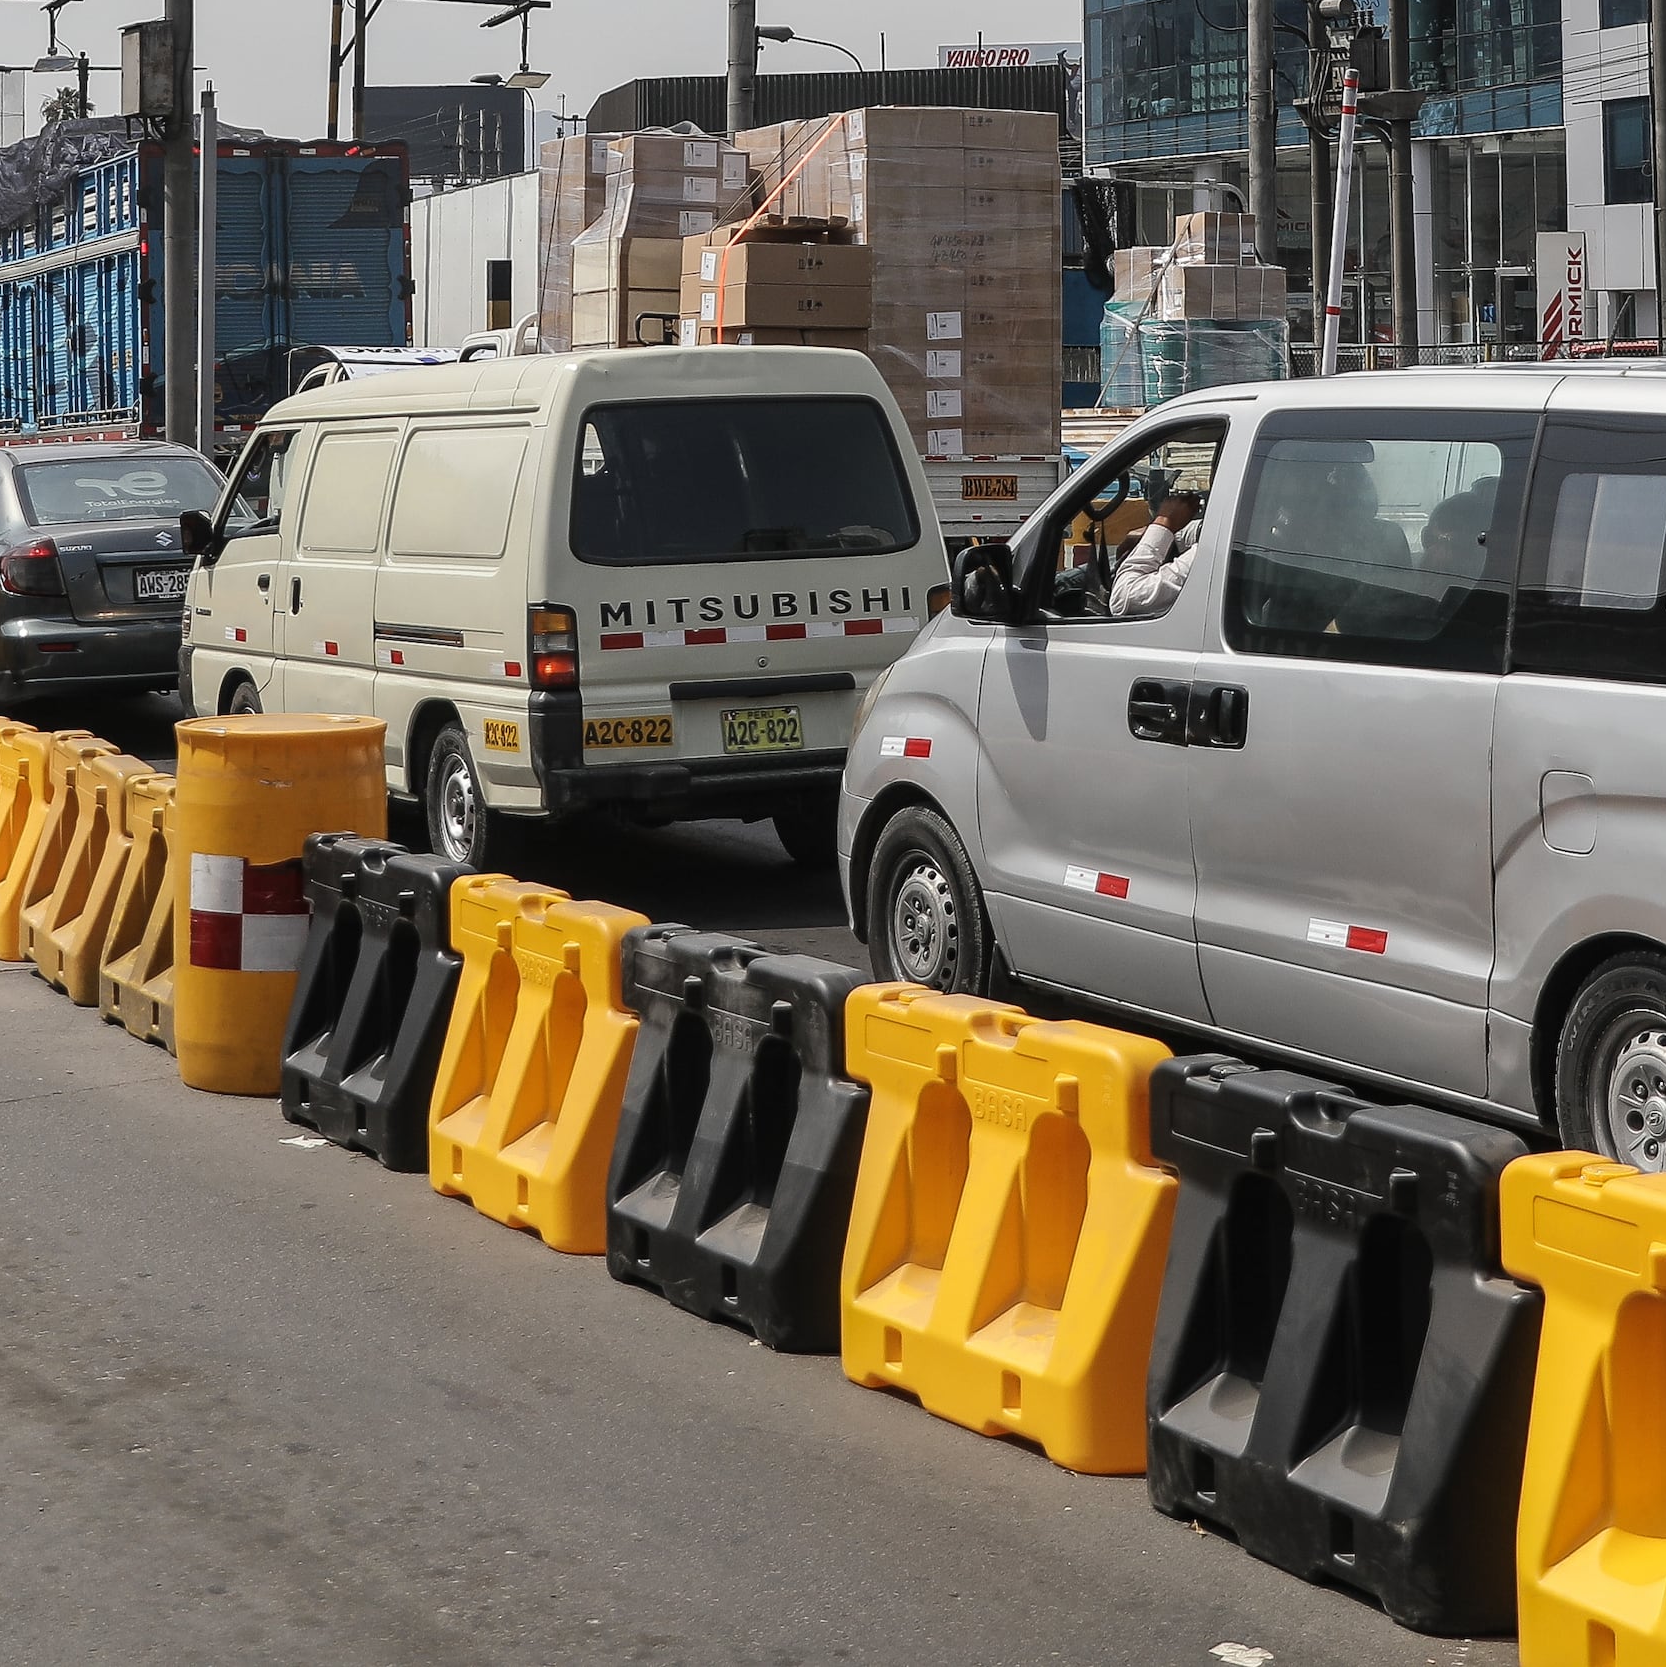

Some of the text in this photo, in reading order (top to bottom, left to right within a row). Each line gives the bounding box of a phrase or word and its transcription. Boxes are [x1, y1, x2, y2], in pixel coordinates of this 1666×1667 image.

[946, 48, 1030, 67] YANGO PRO
[963, 477, 1016, 497] BWE-784
[85, 497, 181, 508] TotalEnergies
[599, 586, 912, 628] MITSUBISHI
[747, 709, 774, 720] PERU
[728, 717, 799, 745] A2C-822
[973, 1086, 1027, 1132] BASA
